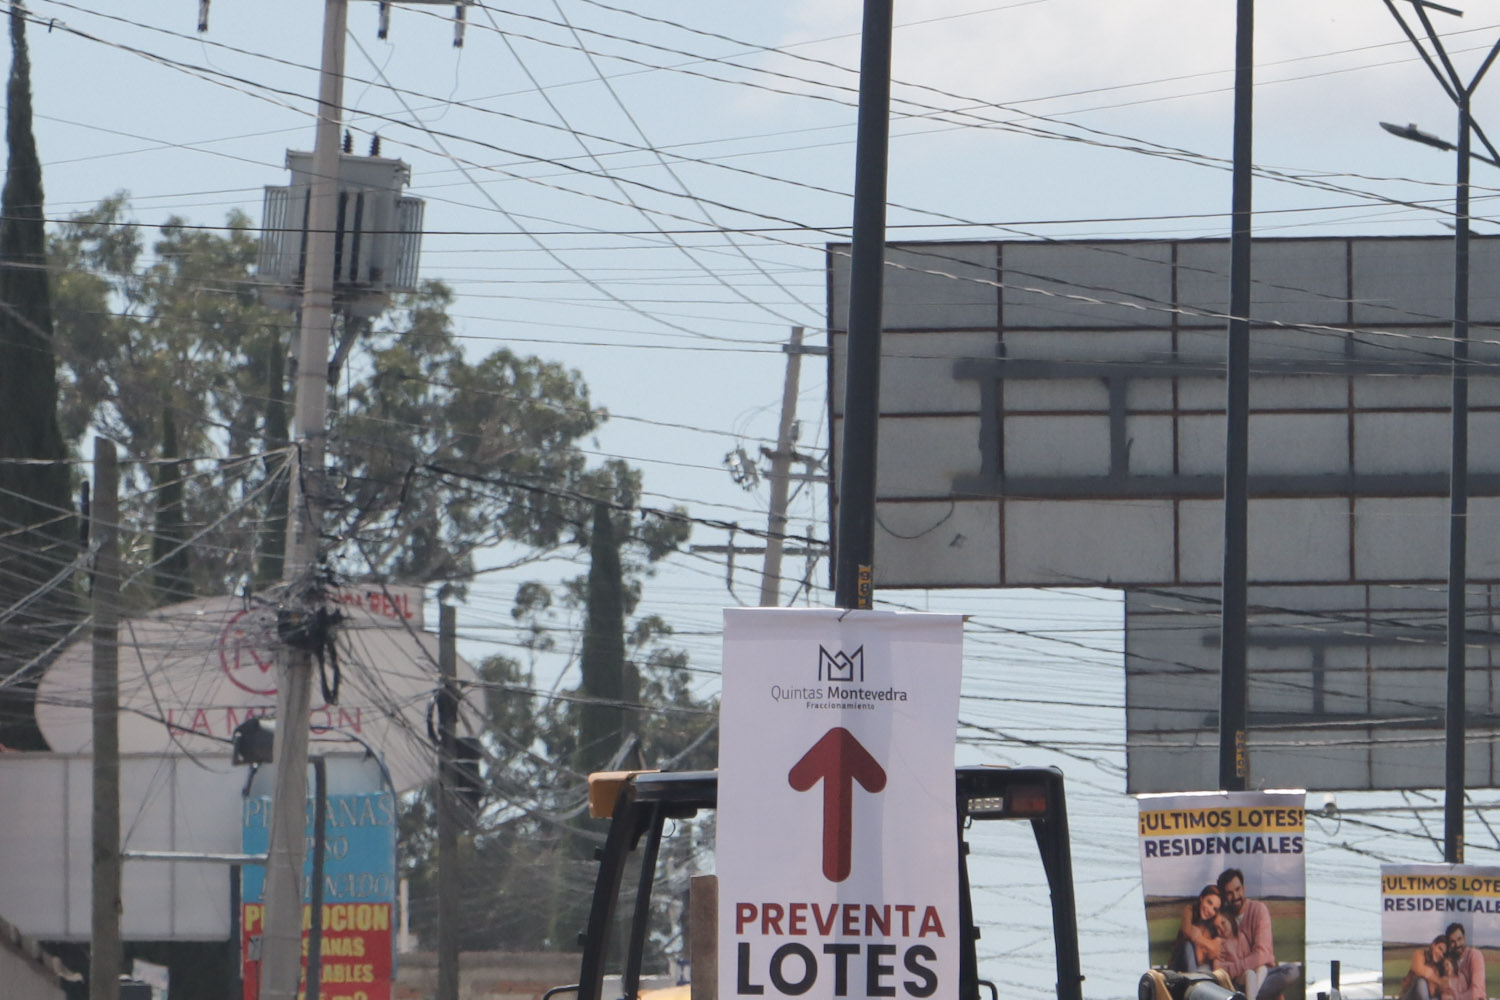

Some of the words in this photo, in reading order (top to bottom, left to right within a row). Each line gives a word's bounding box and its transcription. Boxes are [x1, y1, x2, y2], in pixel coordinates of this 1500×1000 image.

[771, 685, 823, 701] Quintas
[827, 686, 908, 702] Montevedra
[806, 701, 875, 710] Fraccionamiento
[168, 708, 212, 736] LA
[1140, 809, 1233, 835] ¡ULTIMOS
[1237, 808, 1304, 828] LOTES!
[1144, 836, 1304, 858] RESIDENCIALES
[1382, 877, 1458, 893] ¡ULTIMOS
[735, 902, 946, 938] PREVENTA
[737, 942, 939, 998] LOTES
